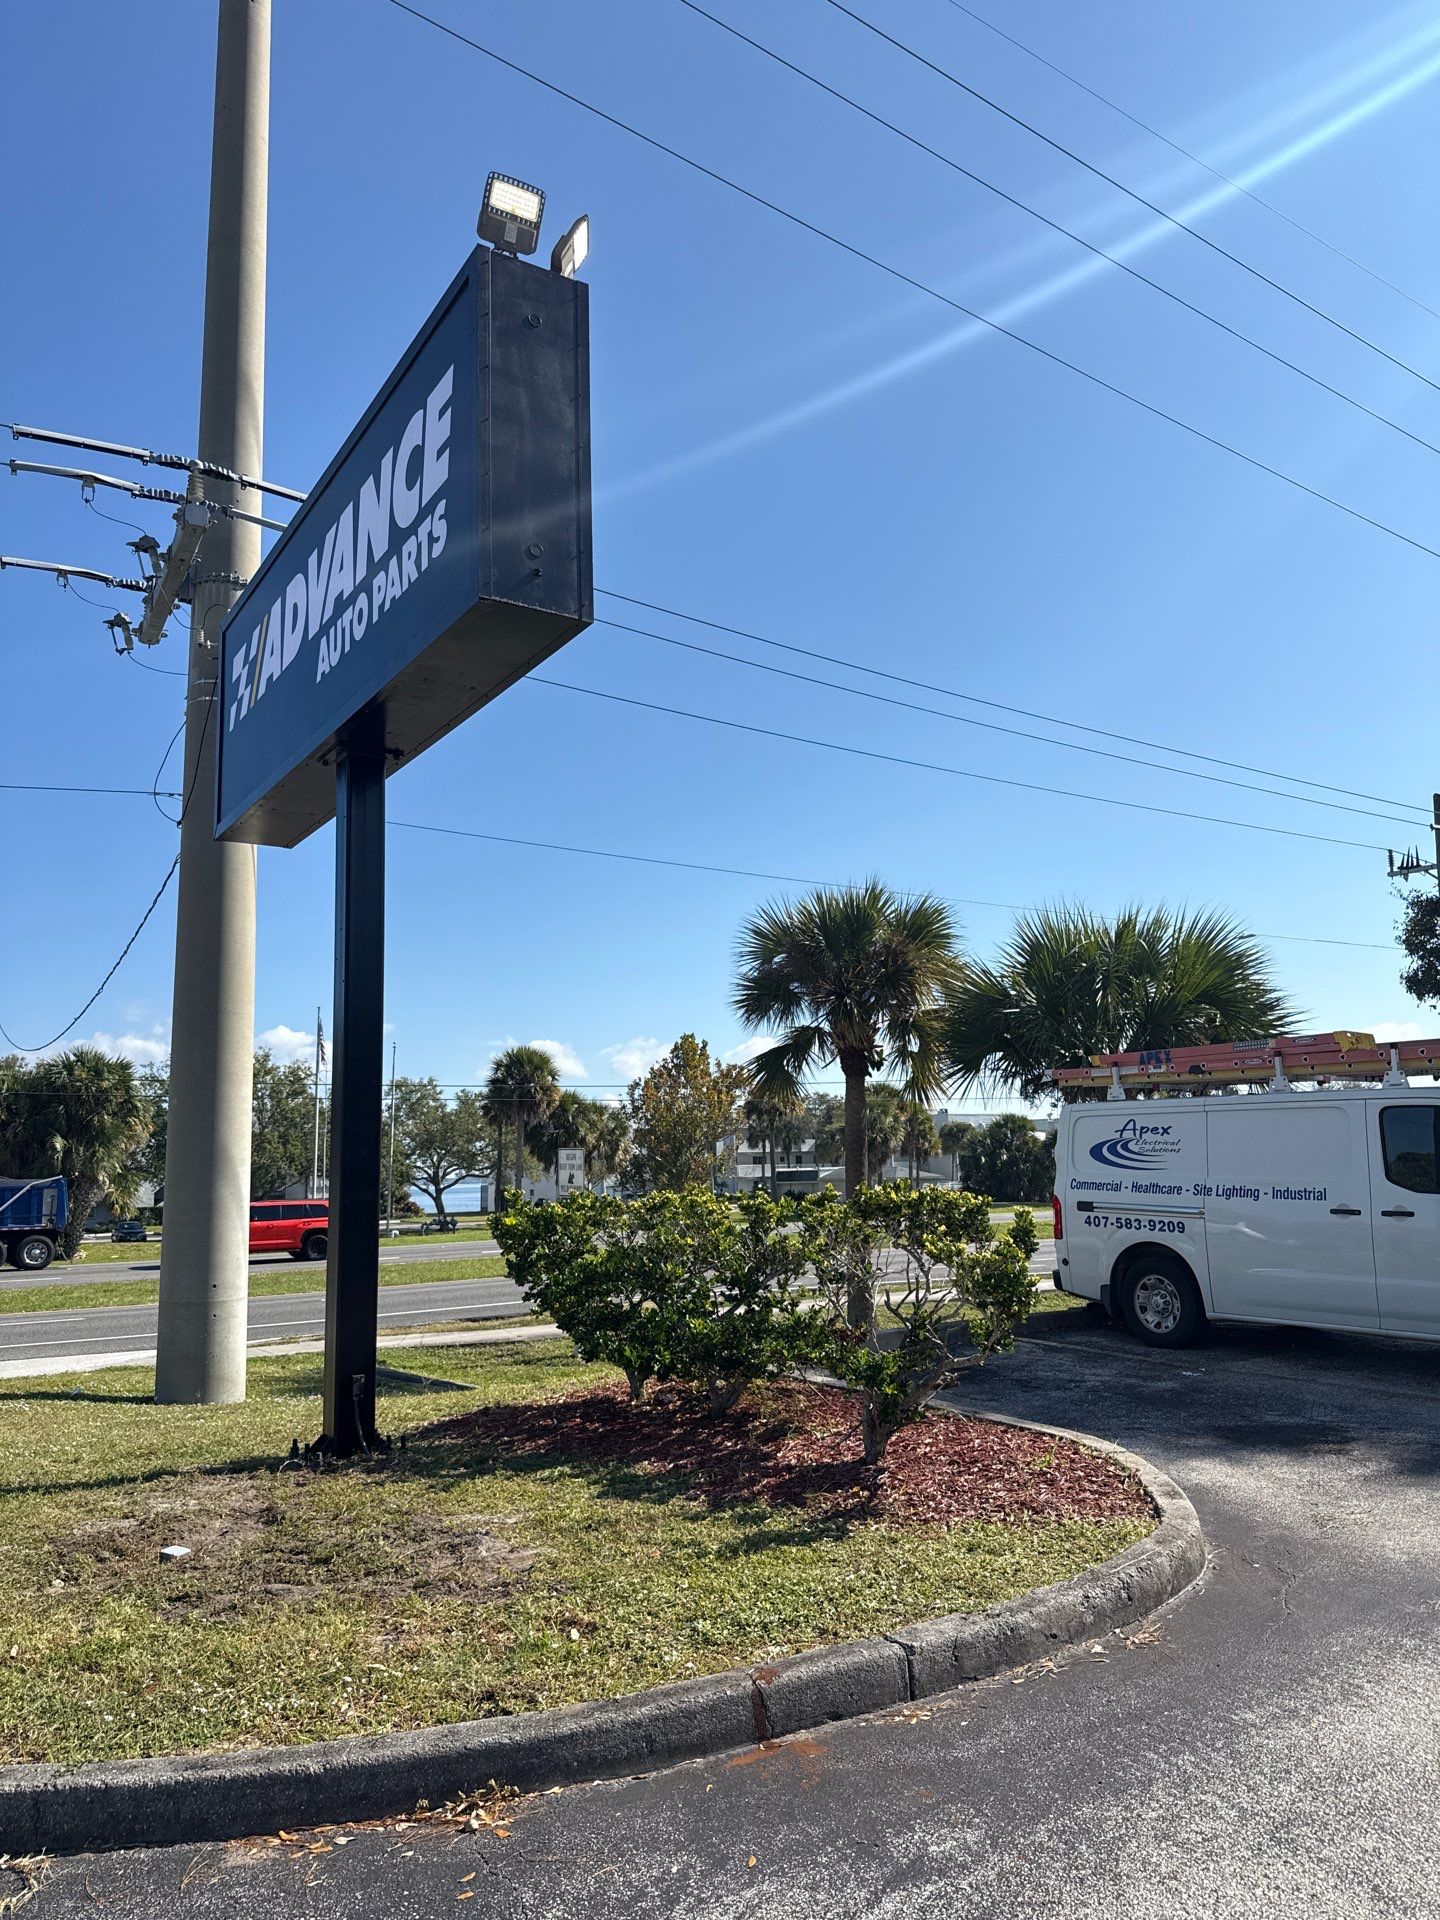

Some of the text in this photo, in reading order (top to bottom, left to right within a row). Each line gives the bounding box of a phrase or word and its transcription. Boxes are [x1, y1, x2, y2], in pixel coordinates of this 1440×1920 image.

[257, 362, 455, 701] ADVANCE
[315, 498, 448, 685] AUTO PARTS
[1139, 1050, 1172, 1065] APEX
[1114, 1118, 1173, 1139] Apex
[1134, 1138, 1181, 1146] Electrical
[1070, 1178, 1123, 1192] Commercial
[1131, 1181, 1183, 1195] Healthcare
[1192, 1183, 1213, 1197] Site
[1215, 1185, 1260, 1201] Lighting
[1272, 1186, 1327, 1201] Industrial
[1084, 1215, 1186, 1234] 407-583-9209
